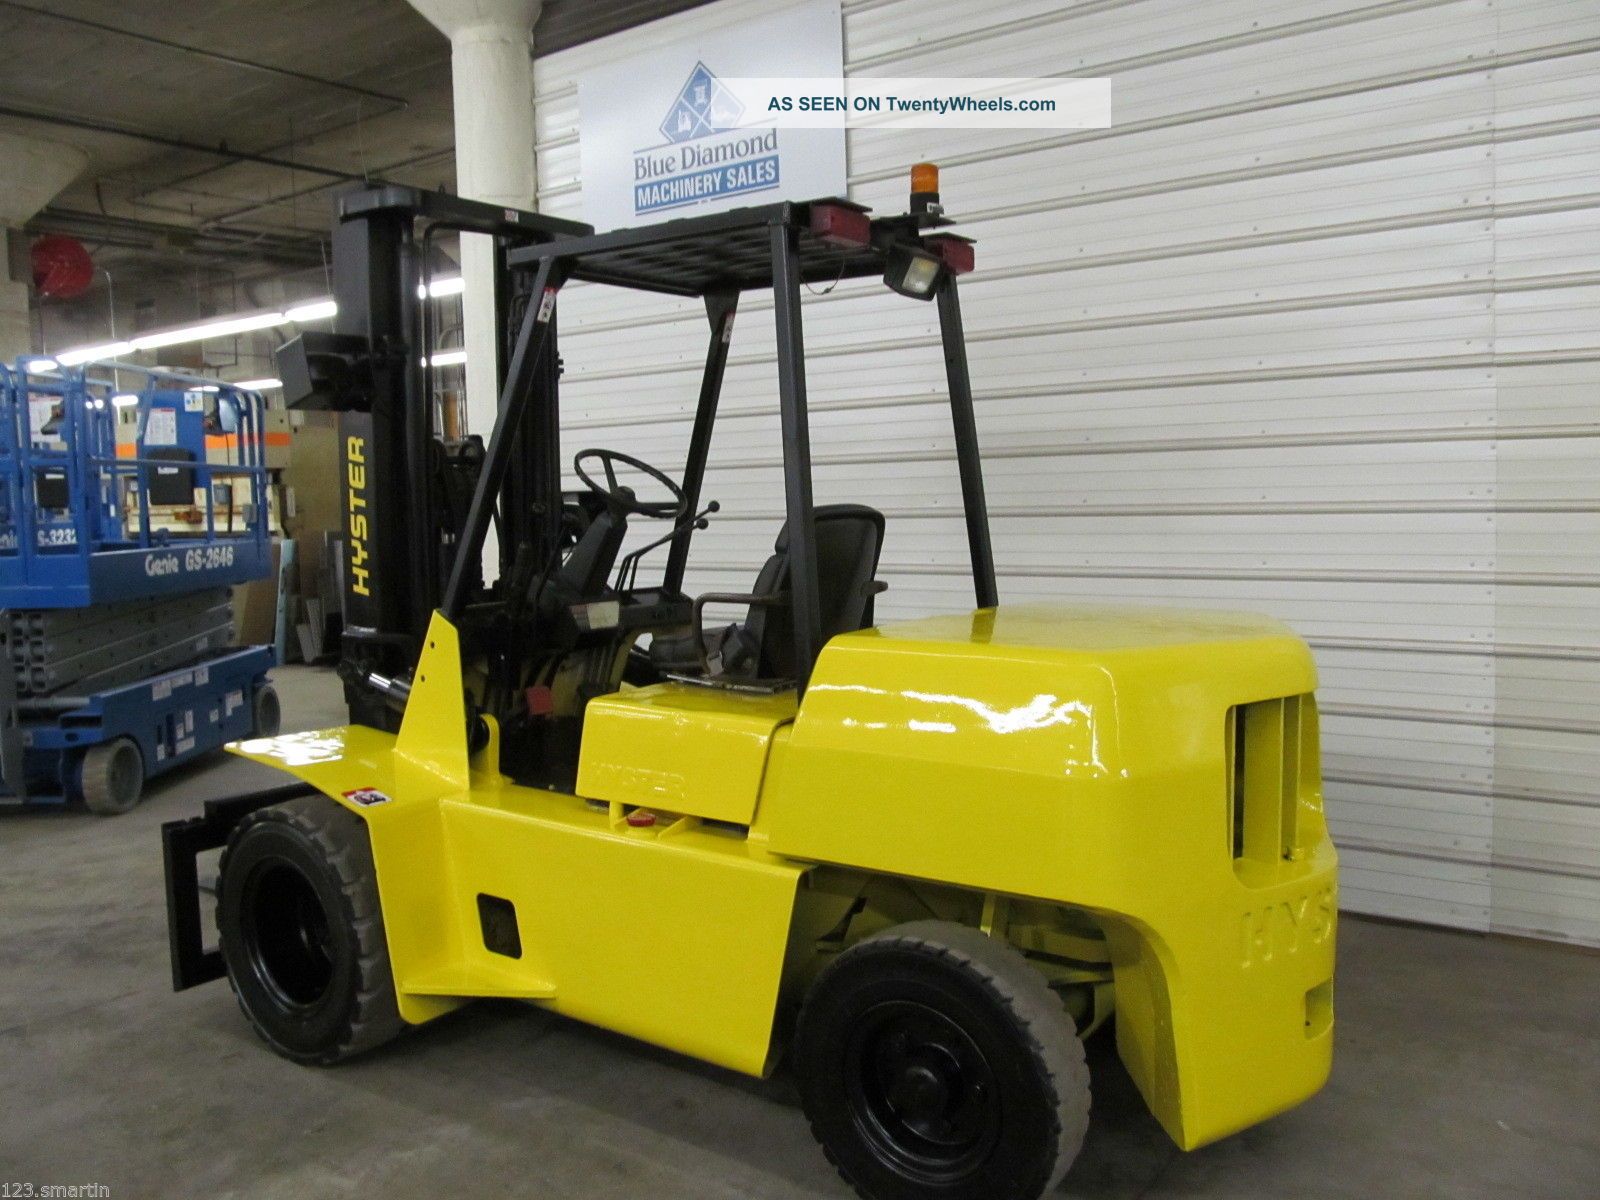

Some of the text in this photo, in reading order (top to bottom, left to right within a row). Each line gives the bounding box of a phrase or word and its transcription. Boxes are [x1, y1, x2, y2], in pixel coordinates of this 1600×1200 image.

[634, 127, 778, 180] Blue Diamond
[637, 159, 776, 207] MACHINERY SALES
[347, 435, 370, 597] HYSTER
[145, 546, 234, 577] Genie GS-2646
